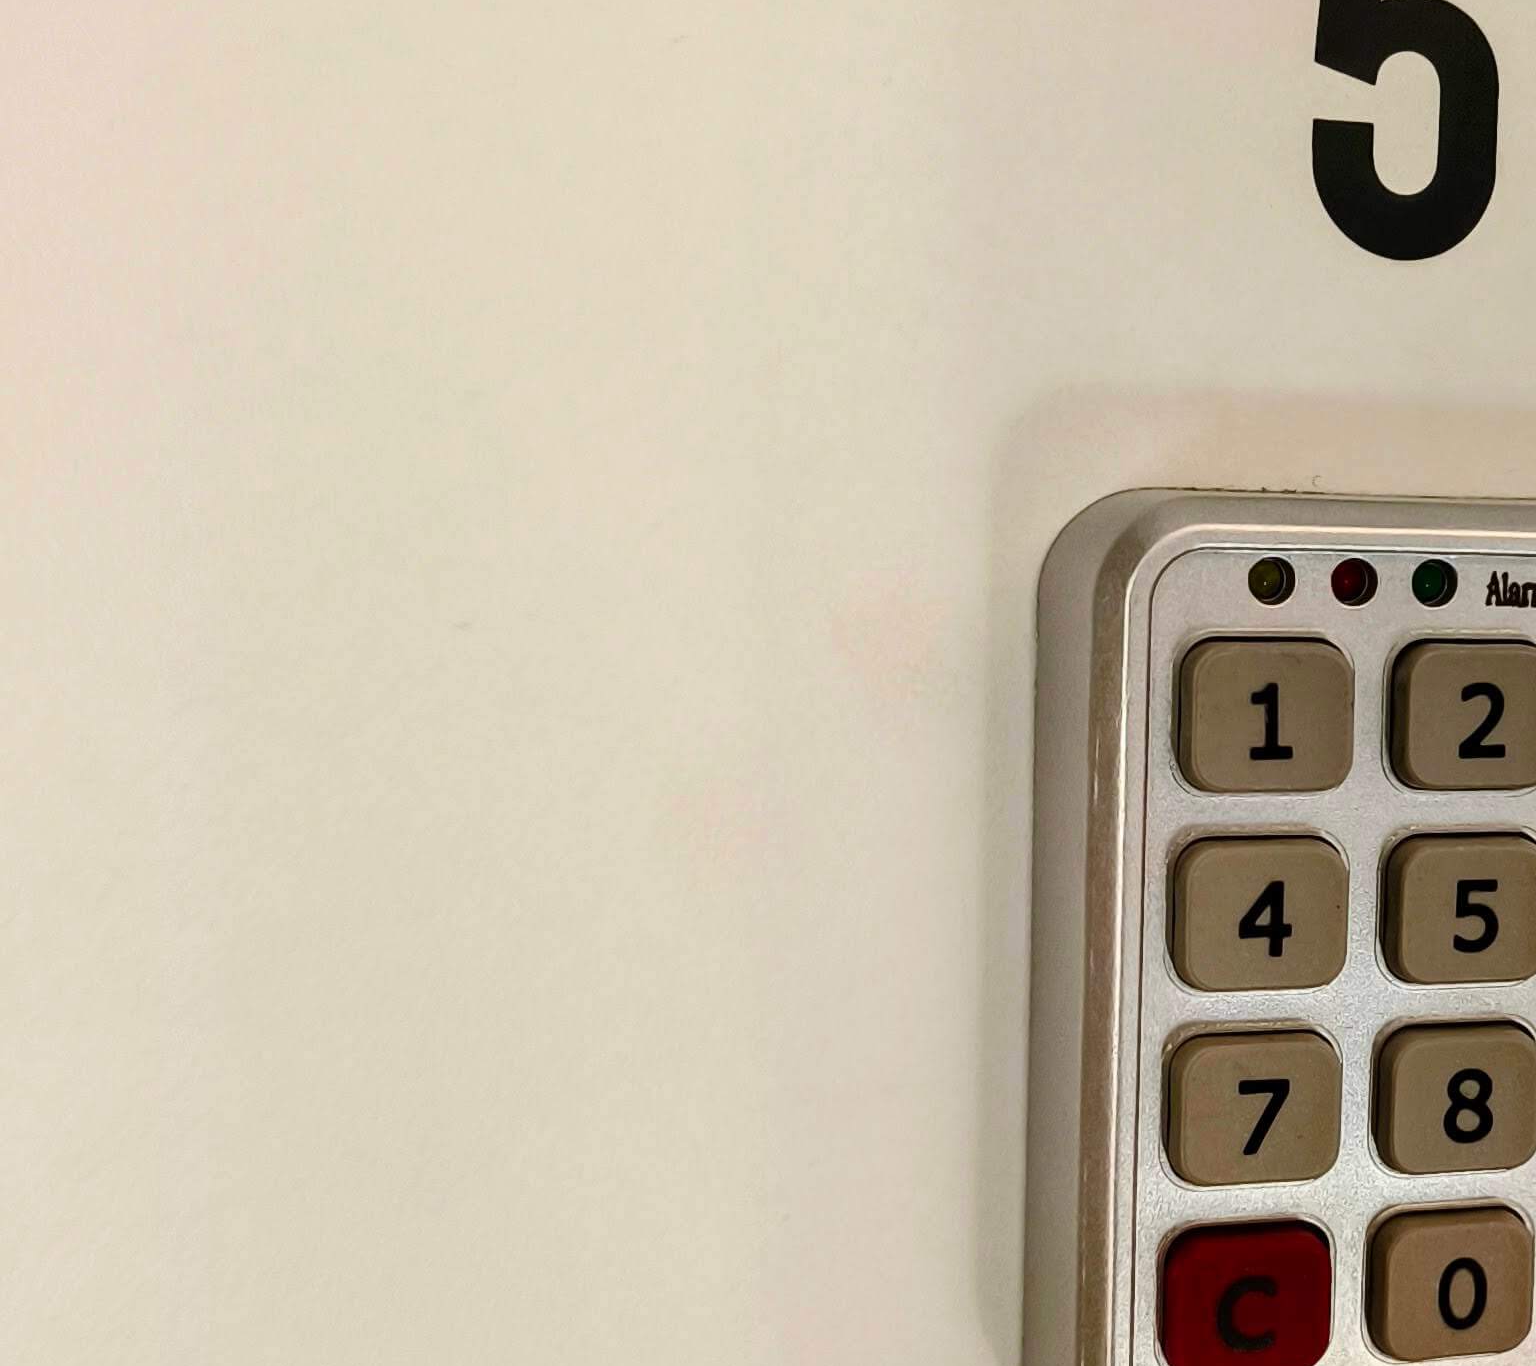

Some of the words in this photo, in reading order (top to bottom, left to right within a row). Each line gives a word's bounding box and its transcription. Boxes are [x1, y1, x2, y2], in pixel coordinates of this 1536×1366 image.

[1249, 682, 1293, 760] 1
[1458, 682, 1506, 759] 2
[1238, 881, 1292, 957] 4
[1453, 879, 1499, 953] 5
[1238, 1078, 1290, 1155] 7
[1443, 1068, 1493, 1144] 8
[1216, 1276, 1277, 1352] C
